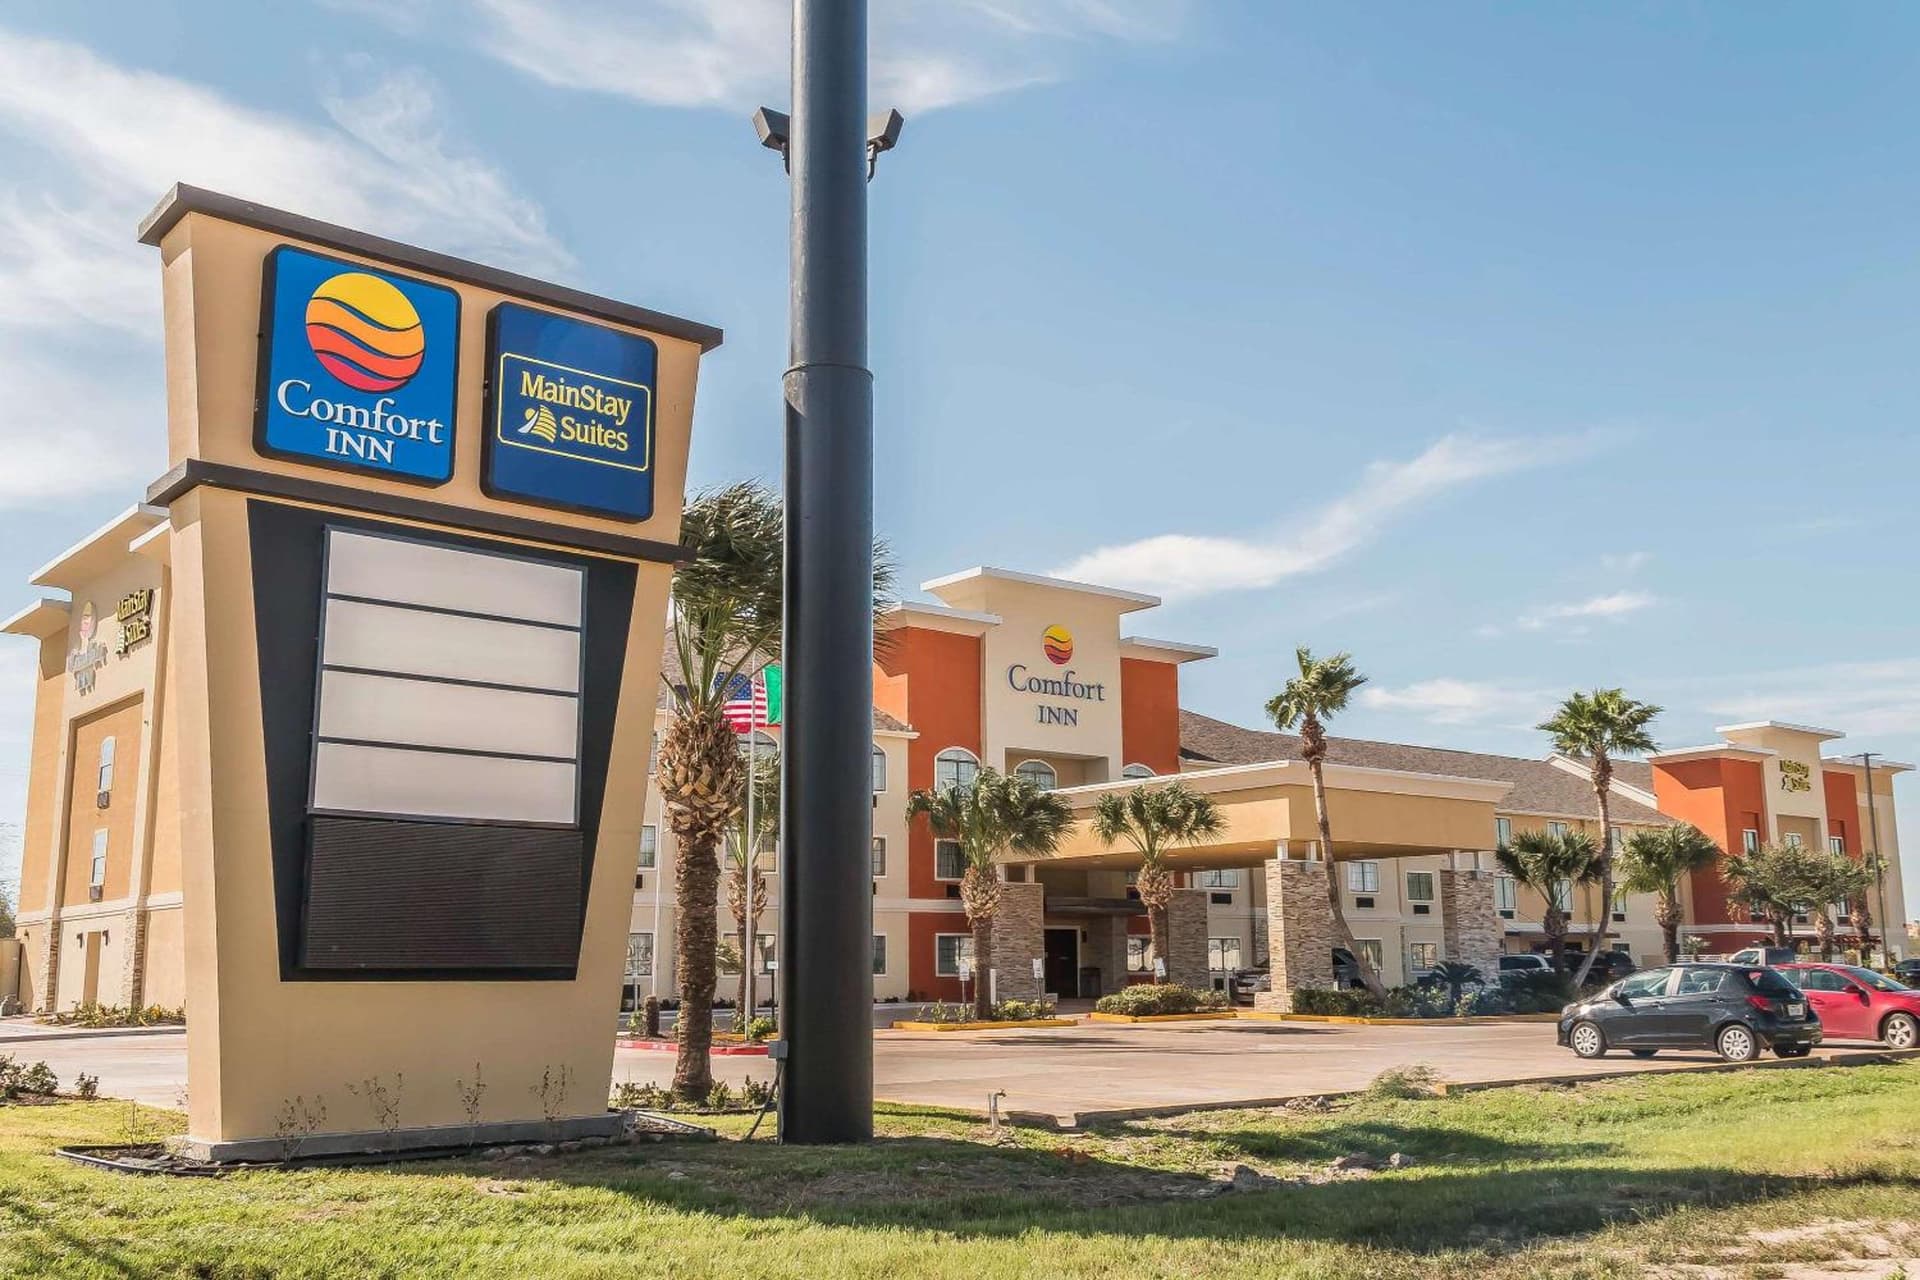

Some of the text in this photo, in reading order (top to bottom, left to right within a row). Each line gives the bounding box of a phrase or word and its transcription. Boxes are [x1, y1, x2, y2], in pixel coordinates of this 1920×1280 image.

[277, 379, 443, 444] Comfort
[520, 369, 632, 426] MainStay
[325, 427, 395, 465] INN
[560, 417, 630, 453] Suites
[1008, 664, 1105, 701] Comfort
[1038, 705, 1078, 726] INN
